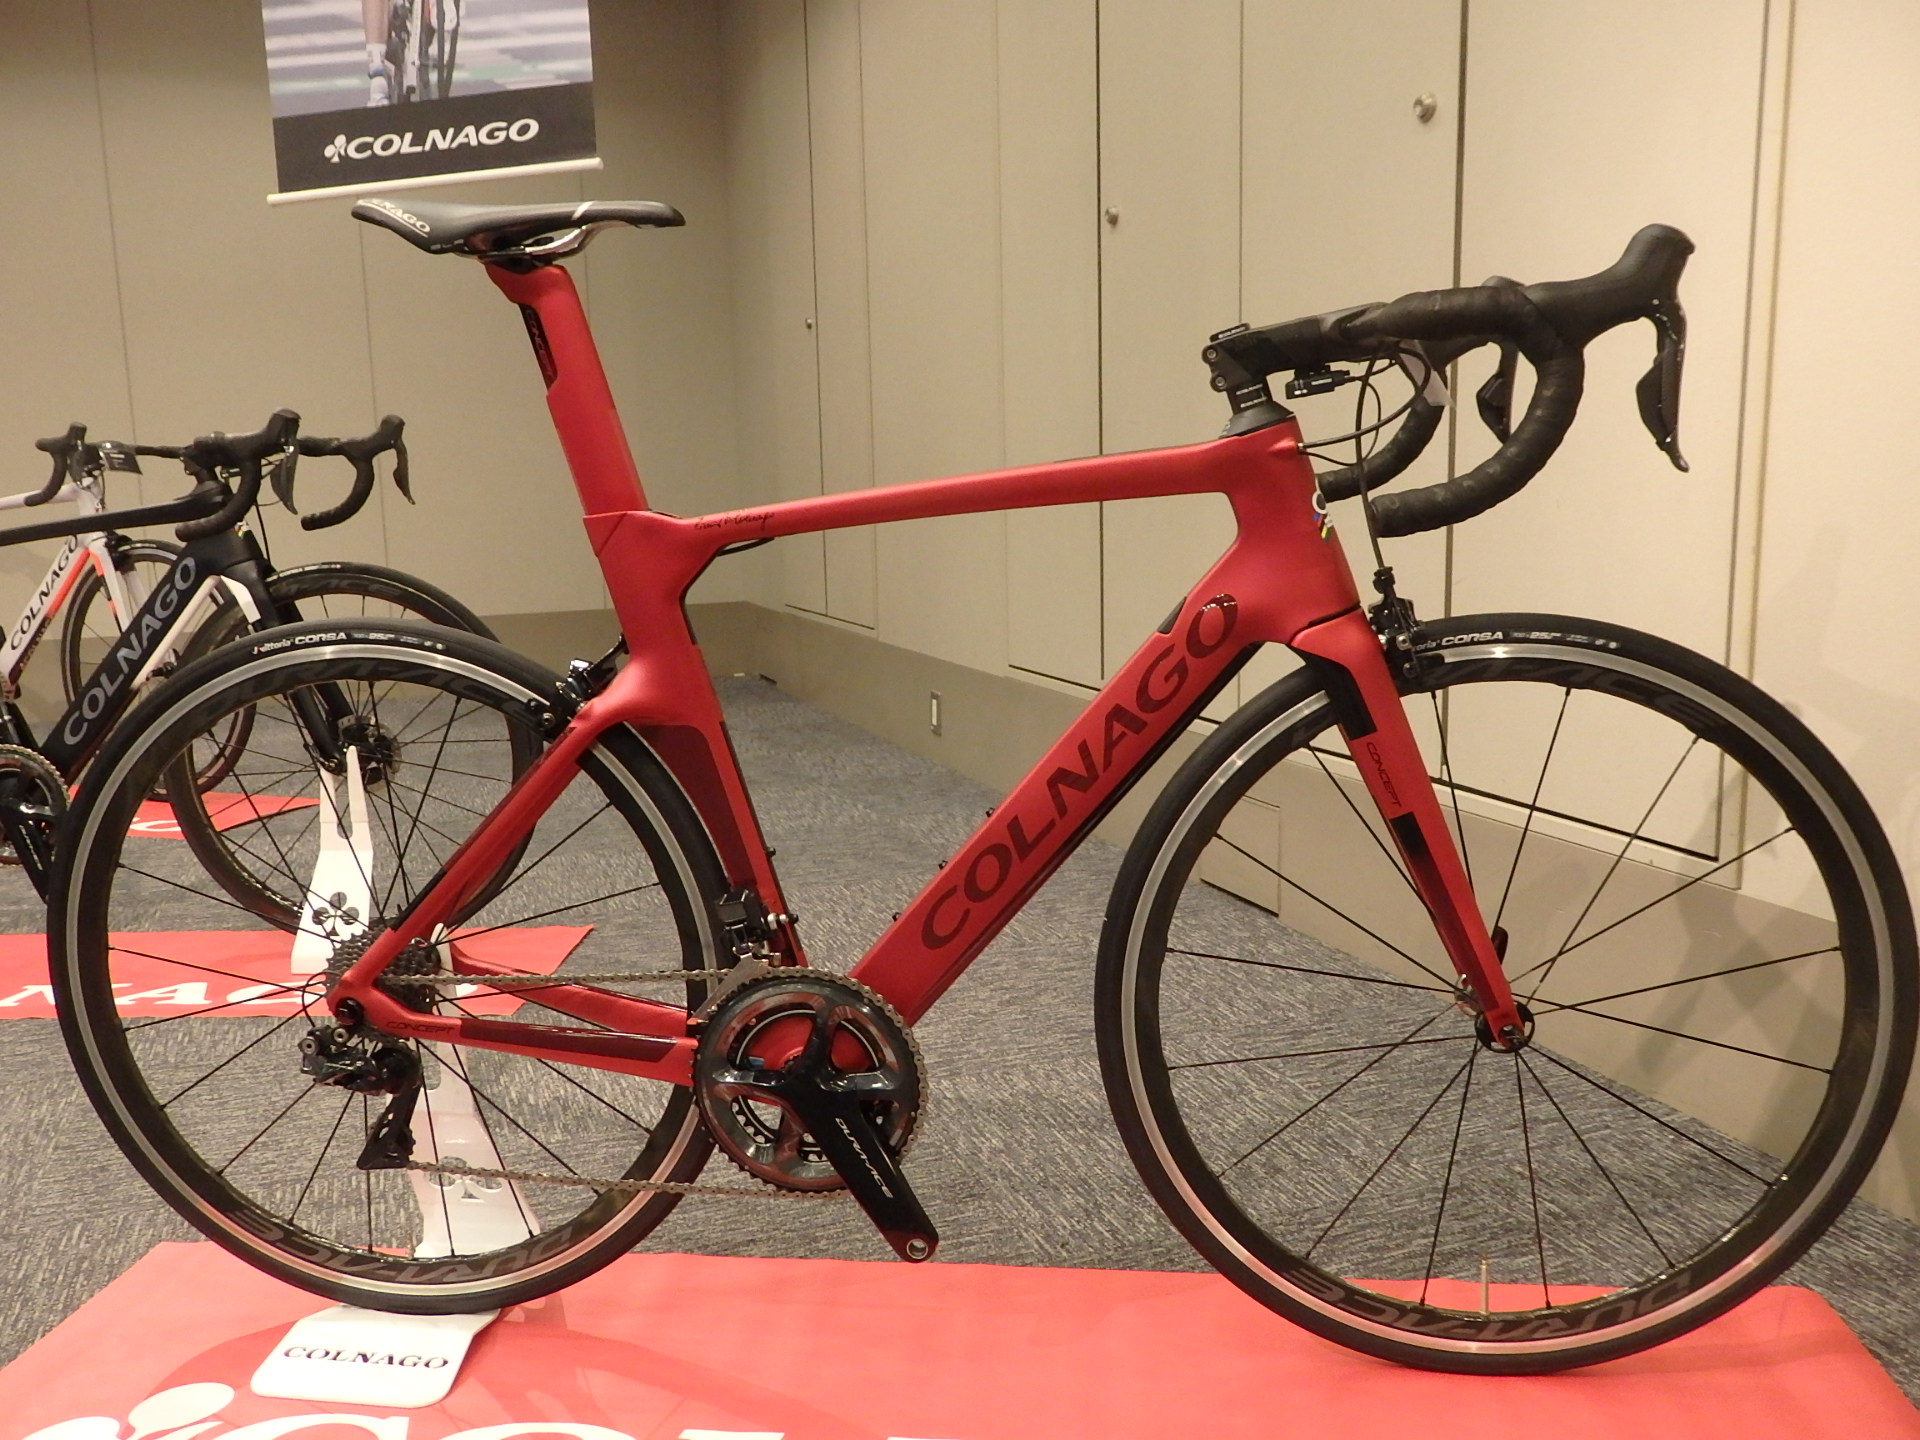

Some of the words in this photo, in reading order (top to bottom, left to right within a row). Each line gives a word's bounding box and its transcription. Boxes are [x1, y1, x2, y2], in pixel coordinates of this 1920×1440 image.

[346, 118, 540, 160] COLNAGO
[10, 534, 79, 652] COLNAGO
[63, 556, 197, 746] COLNAGO
[294, 632, 348, 646] CORSA
[1441, 631, 1504, 647] CORSA
[920, 593, 1239, 951] COLNAGO
[1366, 742, 1402, 808] CONCEPT
[386, 1021, 455, 1034] CONCEPT
[224, 1207, 575, 1284] DURA-ACE
[1284, 1268, 1693, 1341] DURA-ACE
[283, 1346, 449, 1370] COLNAGO
